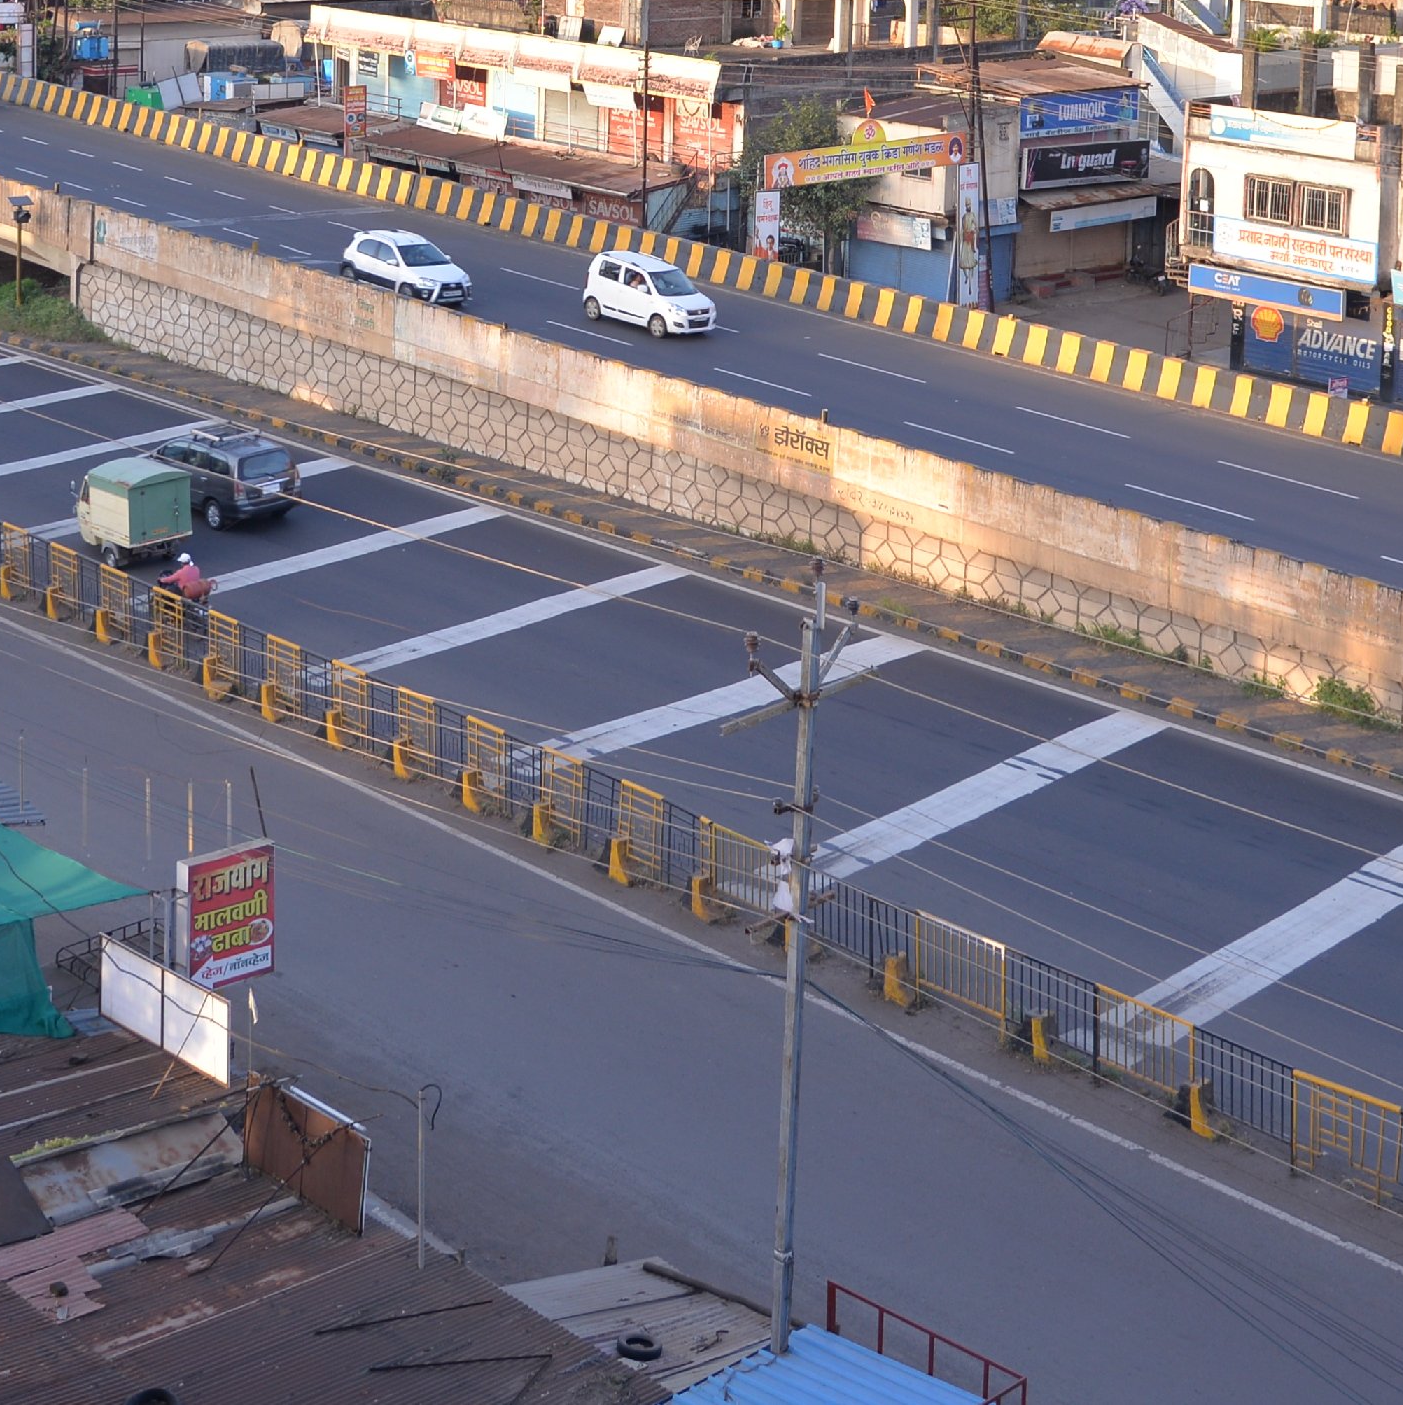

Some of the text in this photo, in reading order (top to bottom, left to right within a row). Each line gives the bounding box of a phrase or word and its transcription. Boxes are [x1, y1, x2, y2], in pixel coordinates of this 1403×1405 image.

[1058, 101, 1107, 121] LUMINOUS
[589, 201, 639, 224] SAVSOL
[1214, 273, 1240, 287] CEAT
[1298, 329, 1377, 361] ADVANCE
[774, 425, 831, 461] झेरॉक्स
[192, 855, 270, 902] राजयोग
[194, 888, 269, 931] मालवणी
[211, 925, 253, 953] ढाबा
